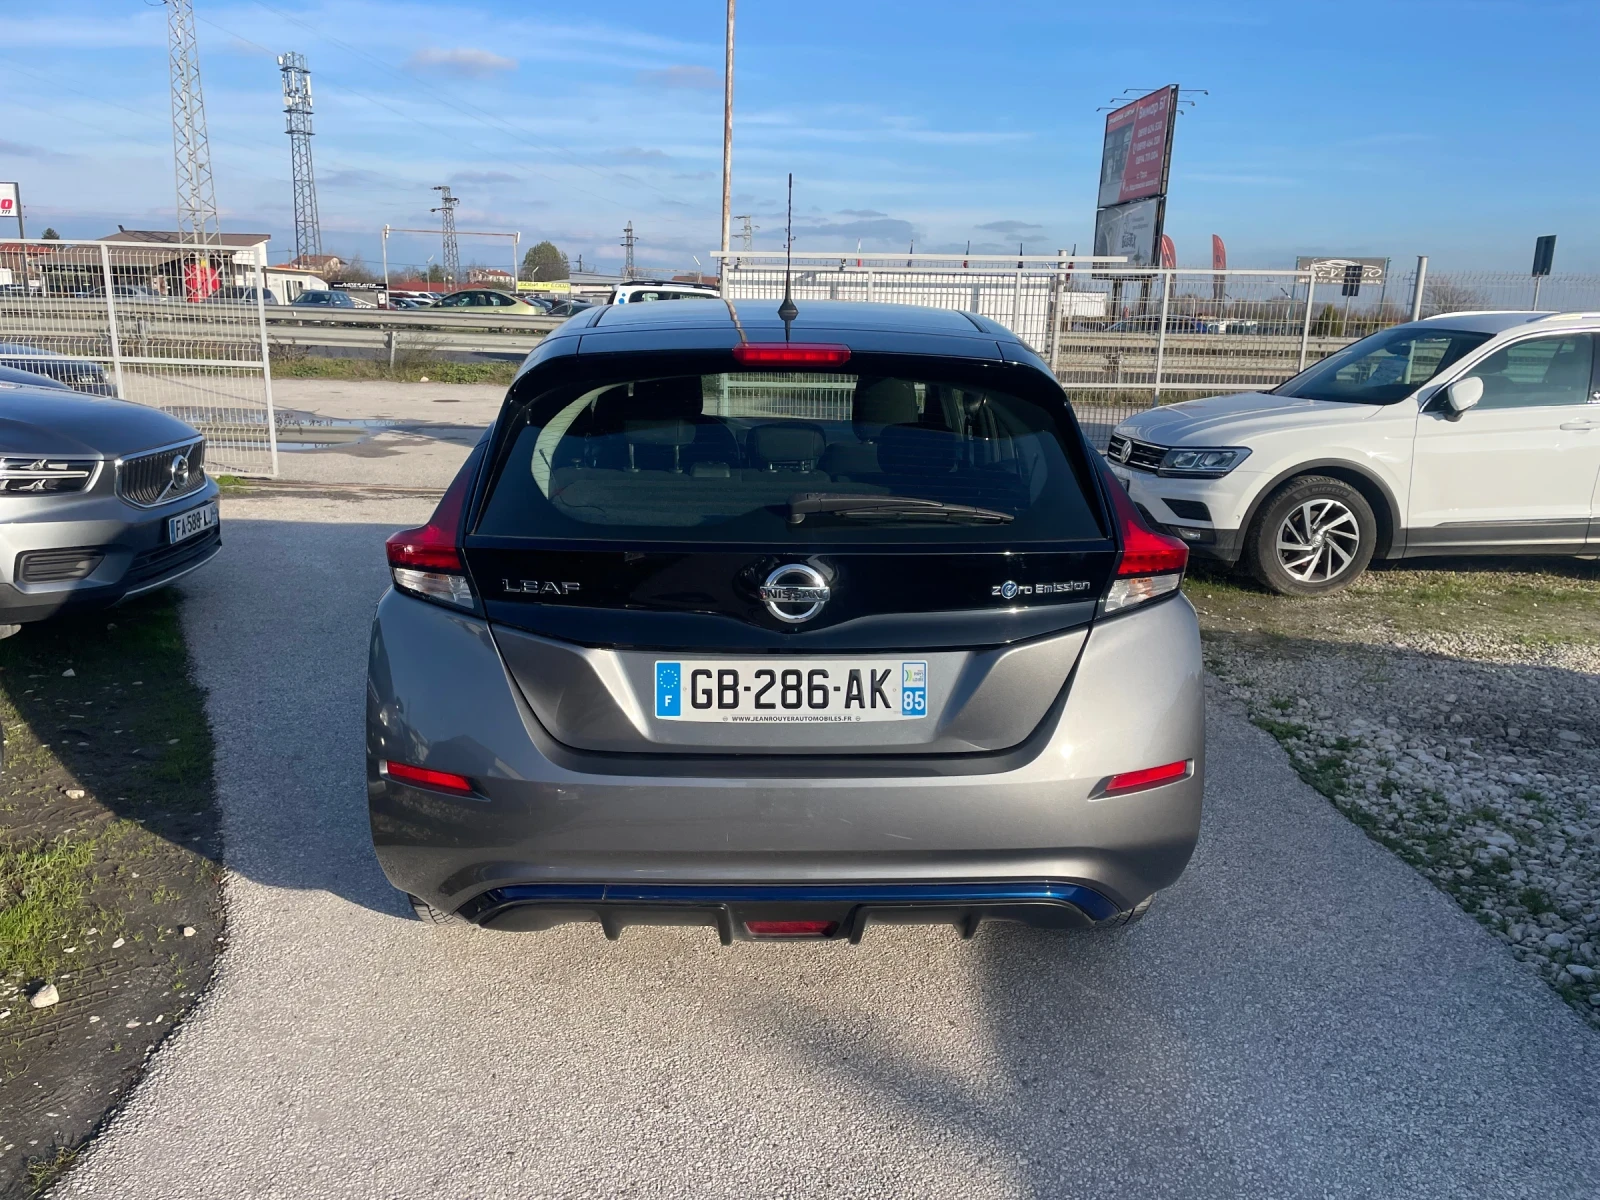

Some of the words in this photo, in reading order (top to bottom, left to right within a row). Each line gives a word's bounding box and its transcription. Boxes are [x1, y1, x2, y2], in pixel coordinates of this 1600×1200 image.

[502, 578, 580, 595] LEAF
[766, 588, 825, 600] NISSAN
[1035, 581, 1091, 594] Emission
[690, 668, 892, 709] GB-286-AK
[664, 695, 673, 707] F
[903, 690, 925, 711] 85
